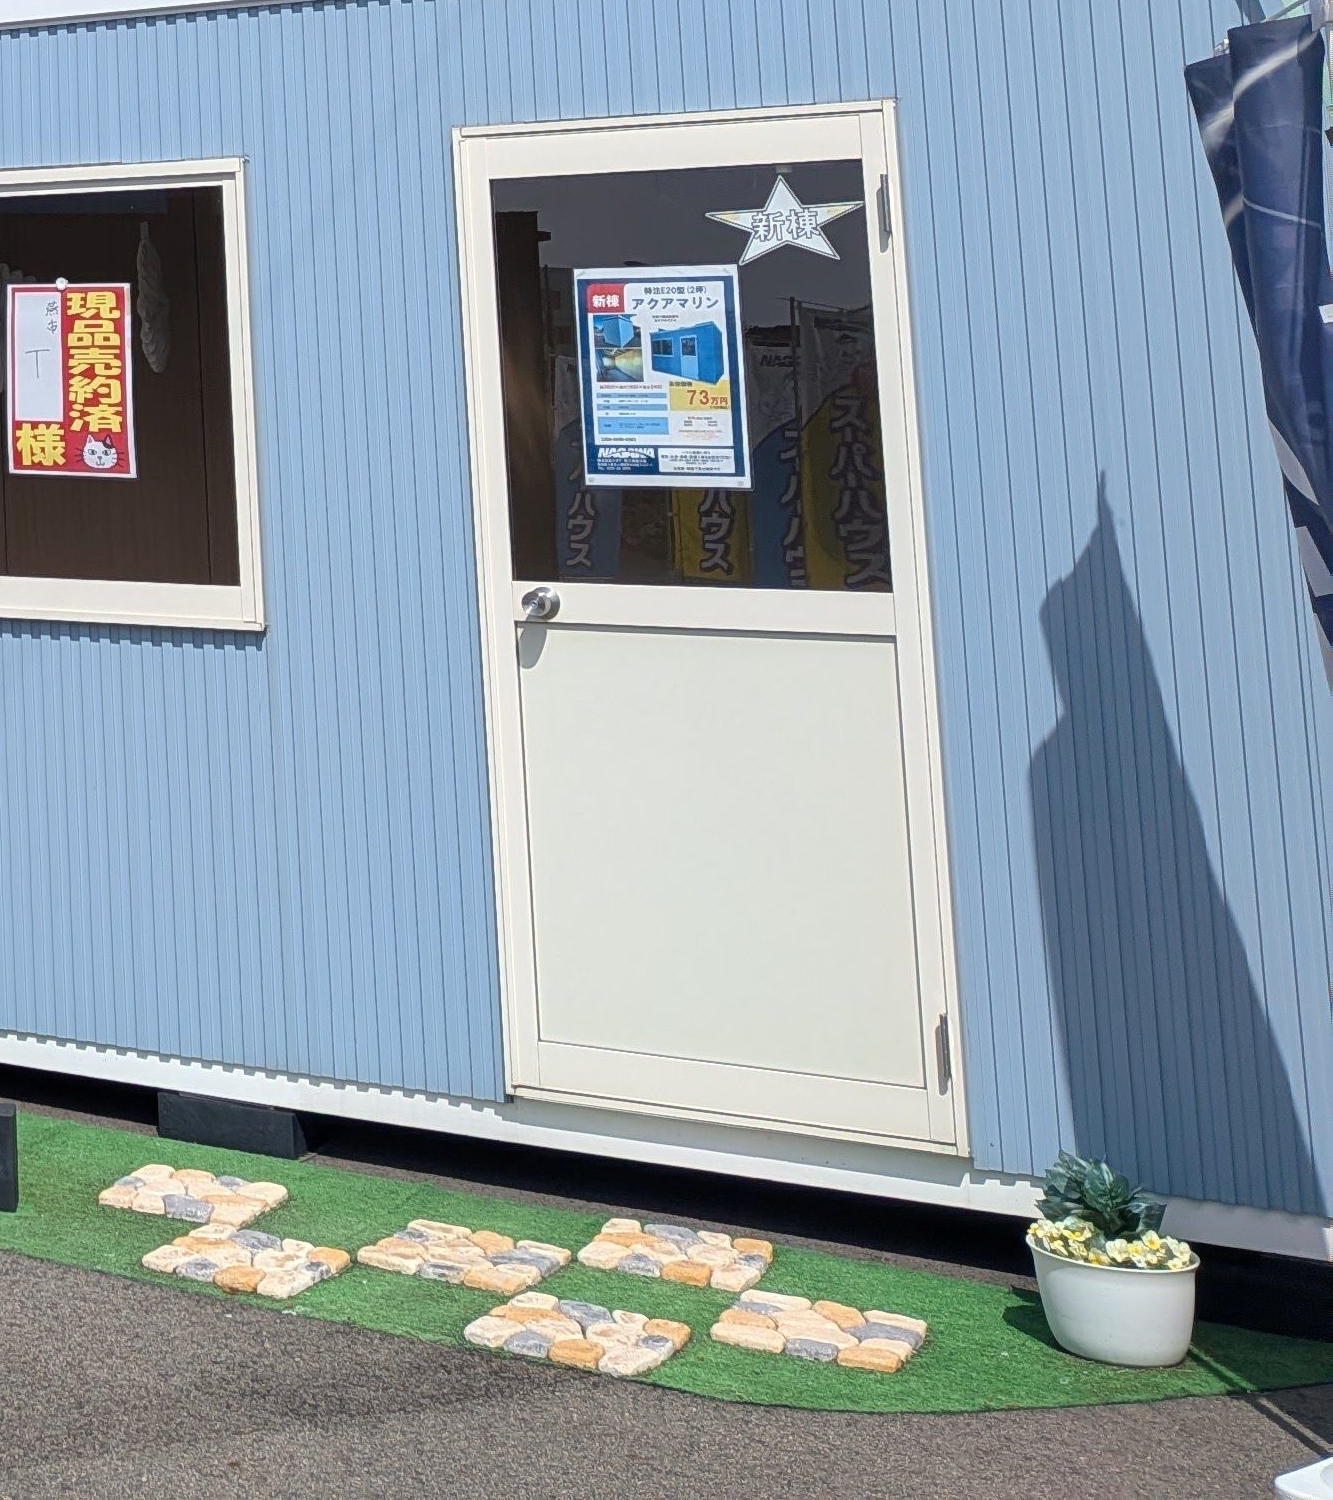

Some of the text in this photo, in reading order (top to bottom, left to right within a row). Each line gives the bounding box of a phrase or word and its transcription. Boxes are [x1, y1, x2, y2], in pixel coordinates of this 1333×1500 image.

[751, 209, 820, 241] 新棟
[592, 294, 620, 308] 新棟
[631, 296, 719, 310] アクアマリン
[66, 291, 123, 433] 現品売約済
[15, 423, 67, 467] 様
